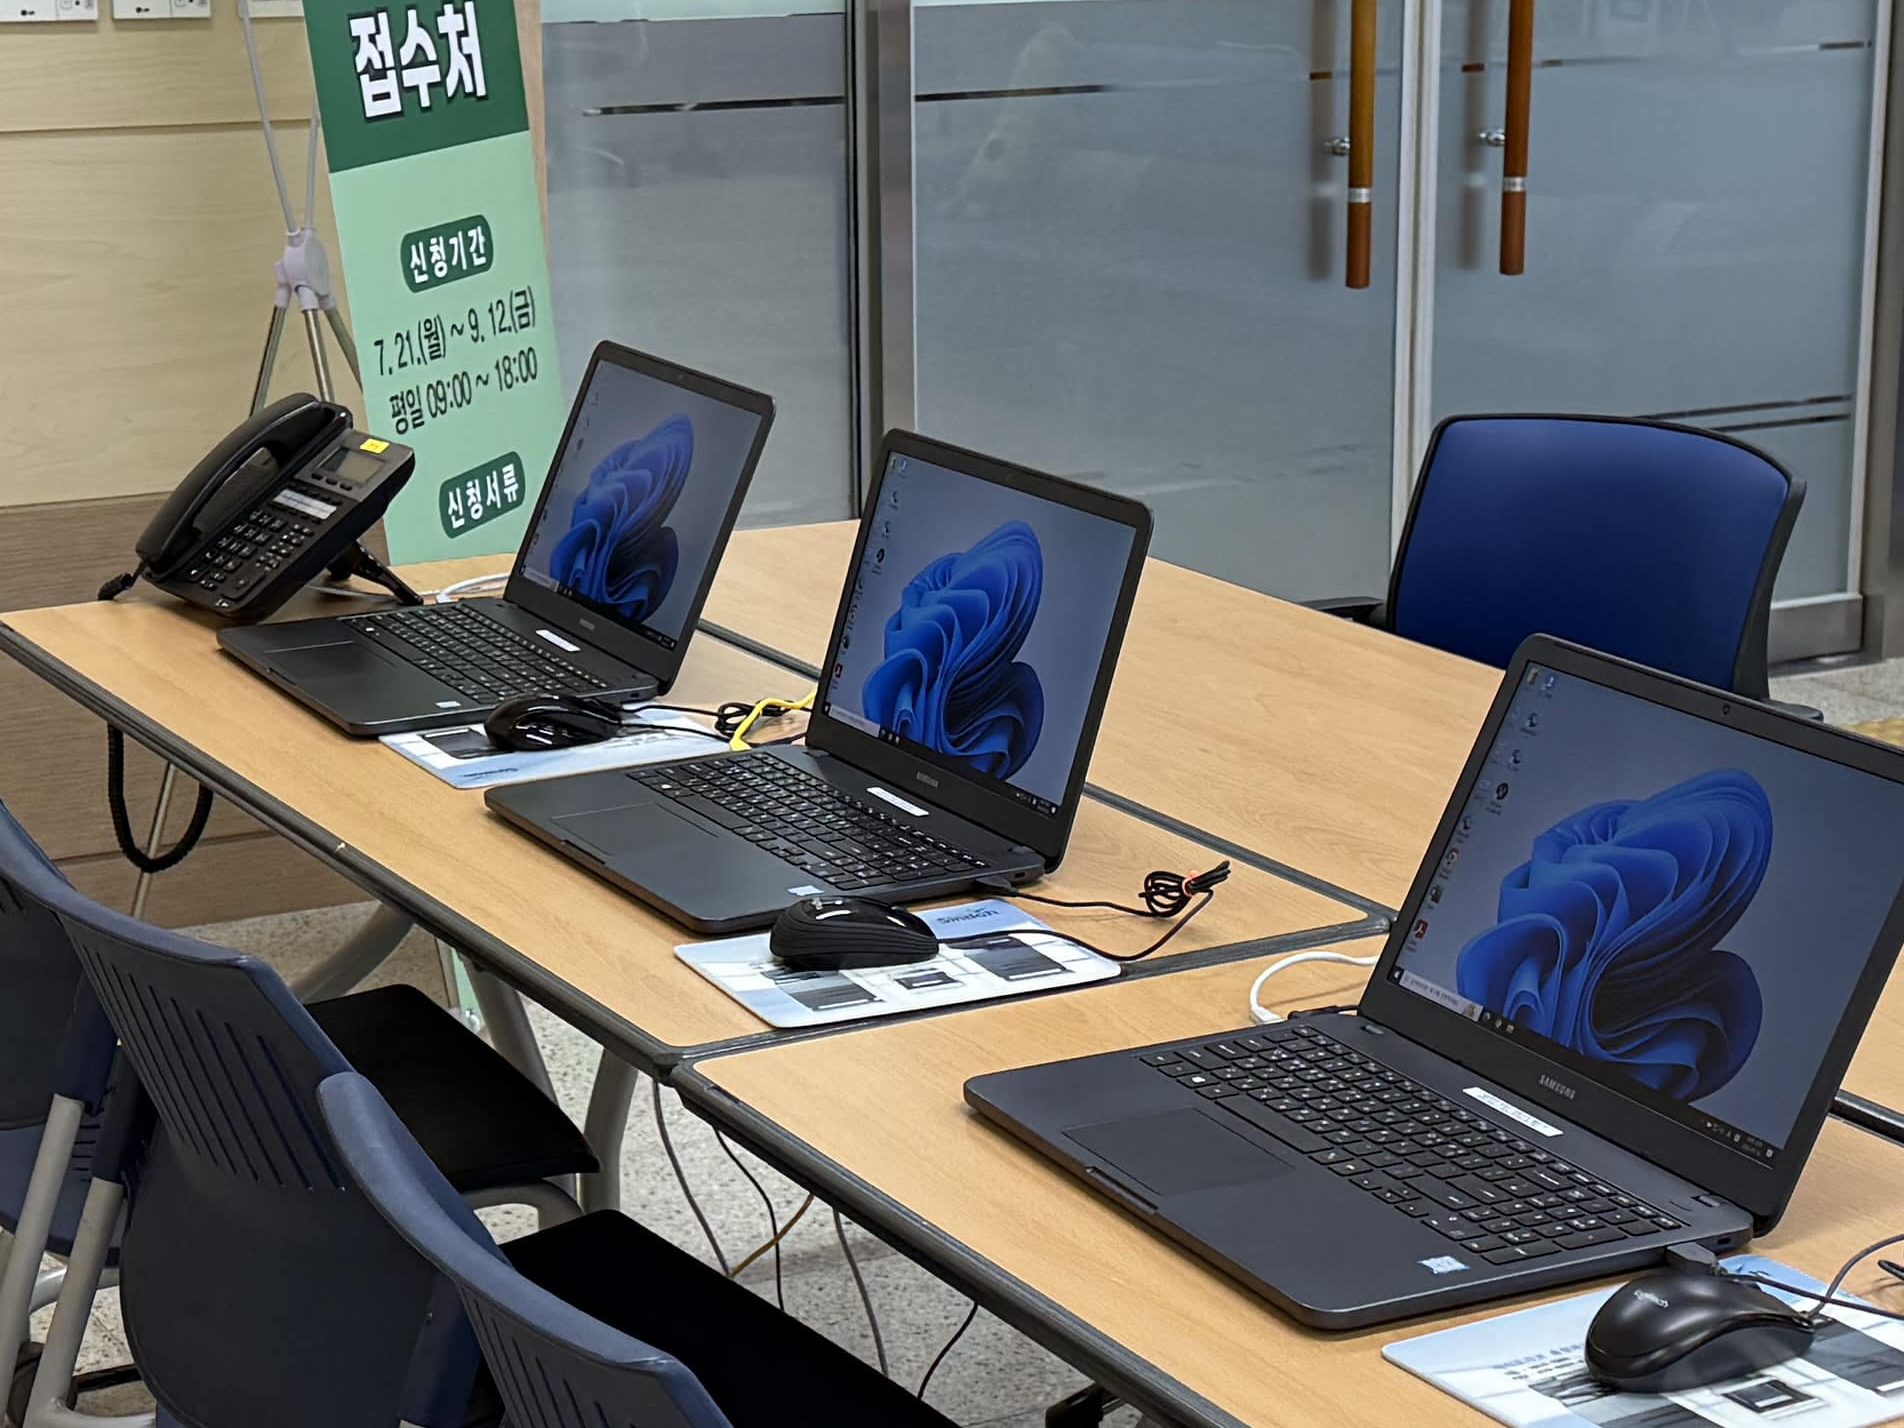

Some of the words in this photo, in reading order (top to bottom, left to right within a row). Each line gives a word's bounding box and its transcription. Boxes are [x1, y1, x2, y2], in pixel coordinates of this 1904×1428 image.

[348, 0, 489, 119] 접수처
[409, 225, 487, 284] 신청기간
[389, 384, 426, 436] 평일
[426, 371, 473, 420] 09:00
[495, 346, 538, 392] 18:00
[447, 463, 519, 530] 신청서류
[1538, 1074, 1577, 1101] SAMSUNG
